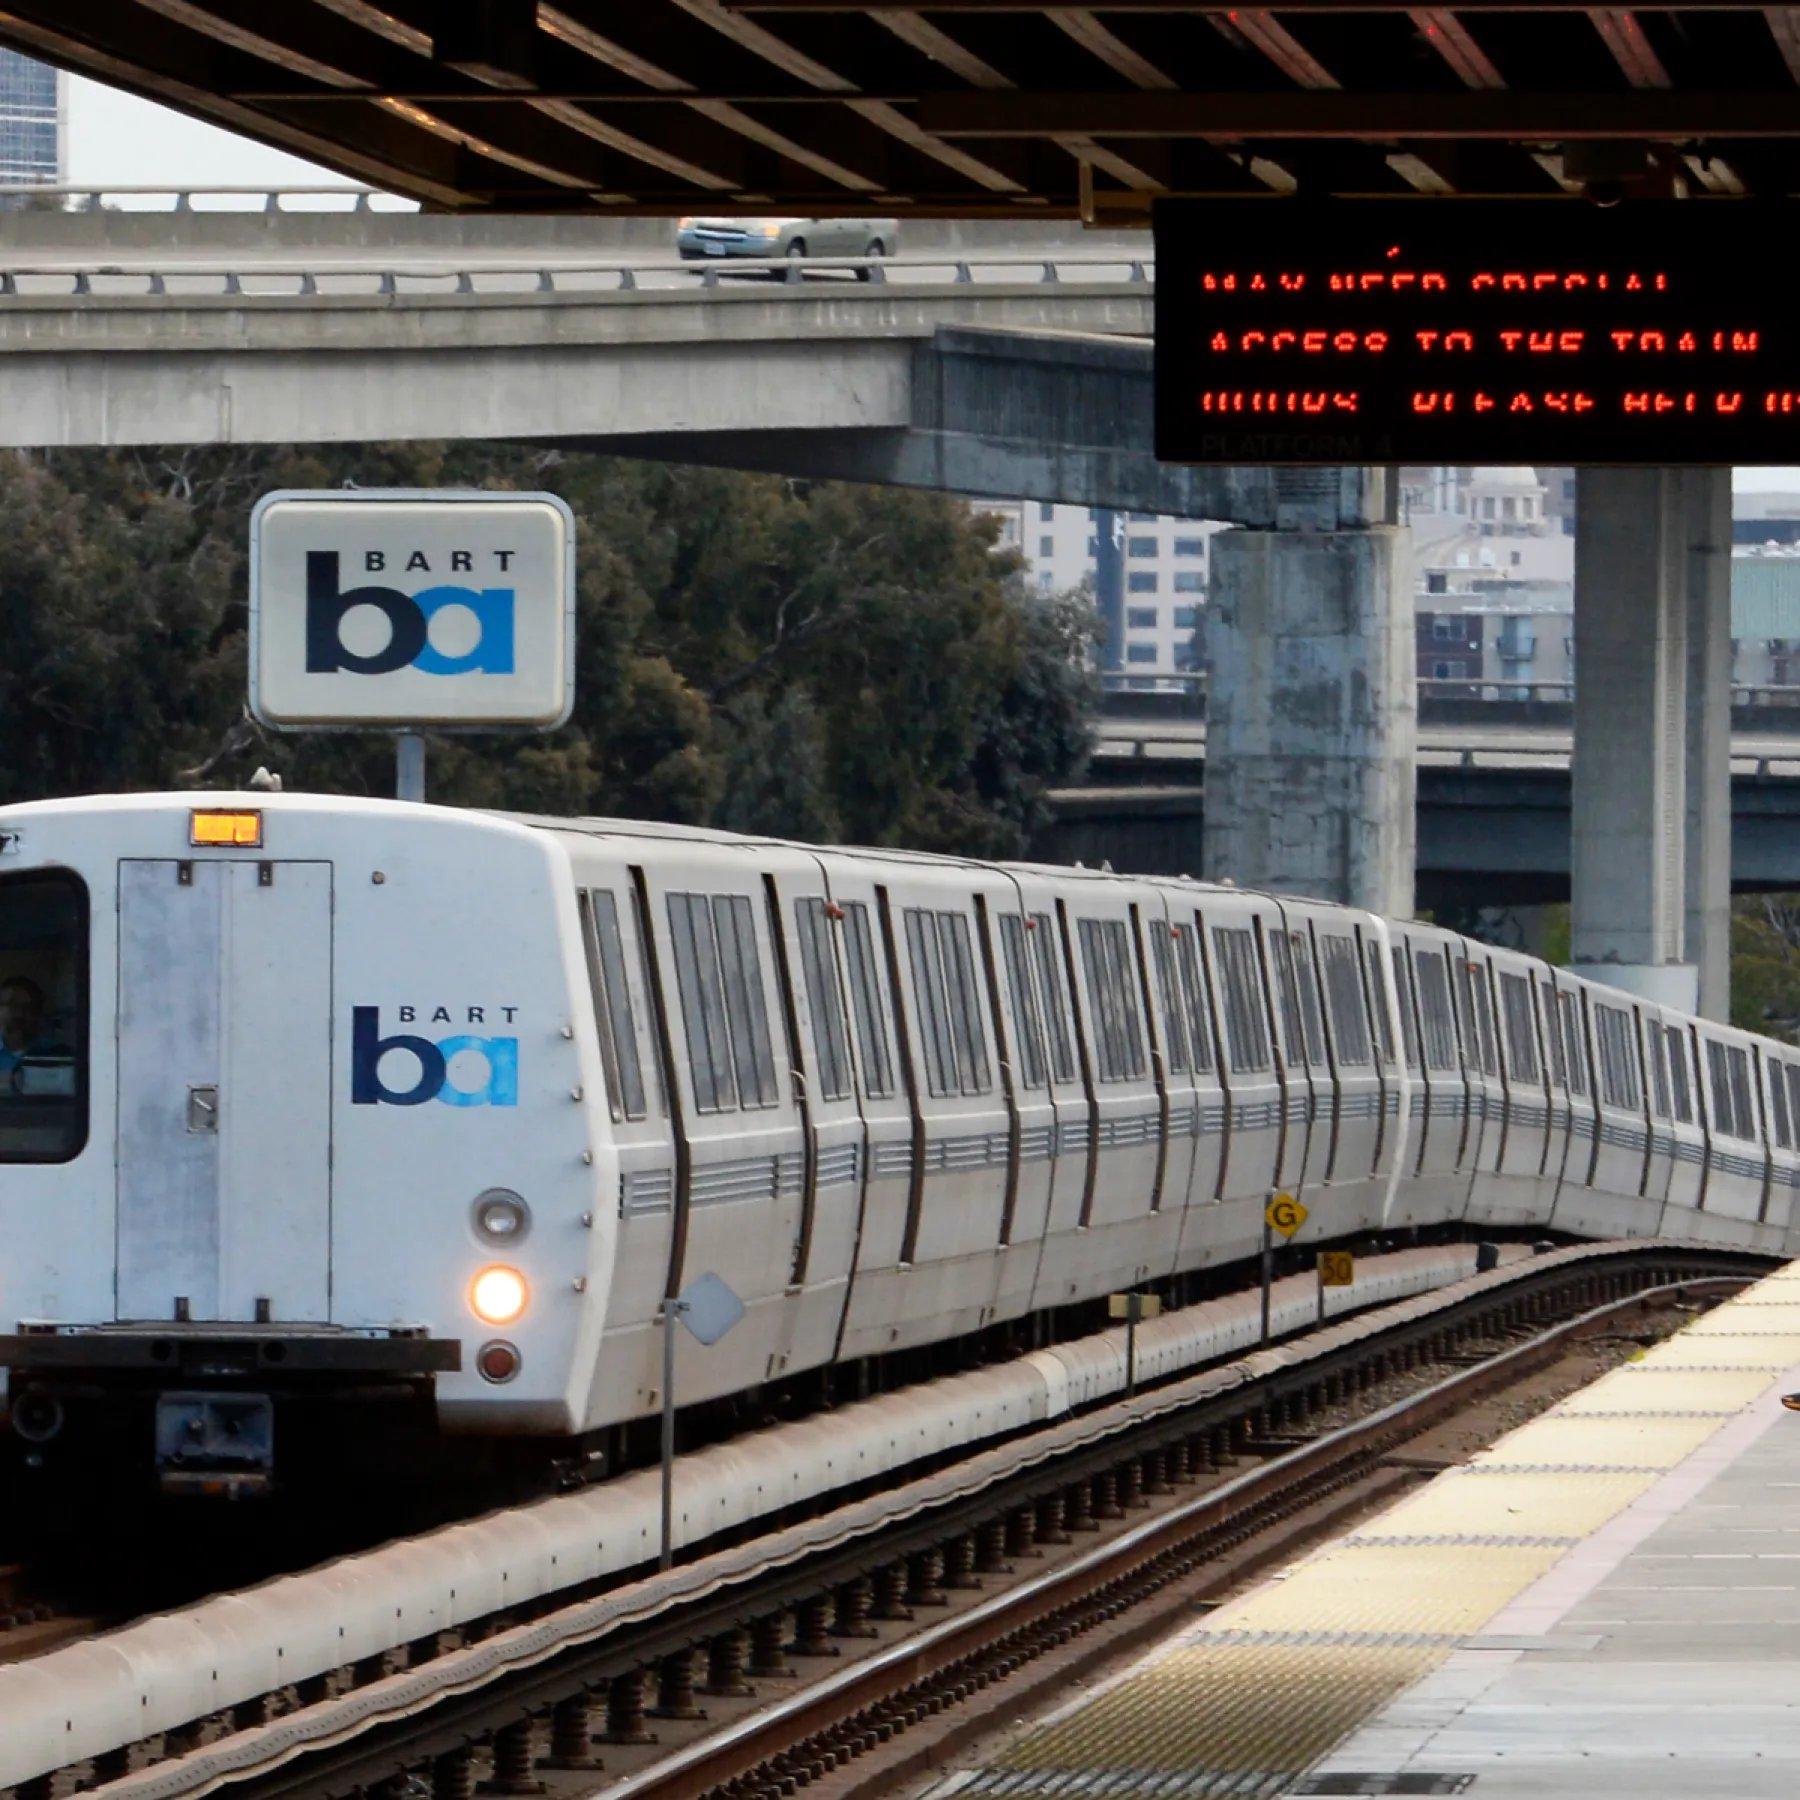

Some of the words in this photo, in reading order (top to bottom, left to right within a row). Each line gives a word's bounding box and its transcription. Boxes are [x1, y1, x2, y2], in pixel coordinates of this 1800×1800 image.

[364, 550, 516, 572] BART
[399, 1005, 519, 1023] BART
[1272, 1203, 1297, 1227] G
[1322, 1256, 1352, 1281] 50
